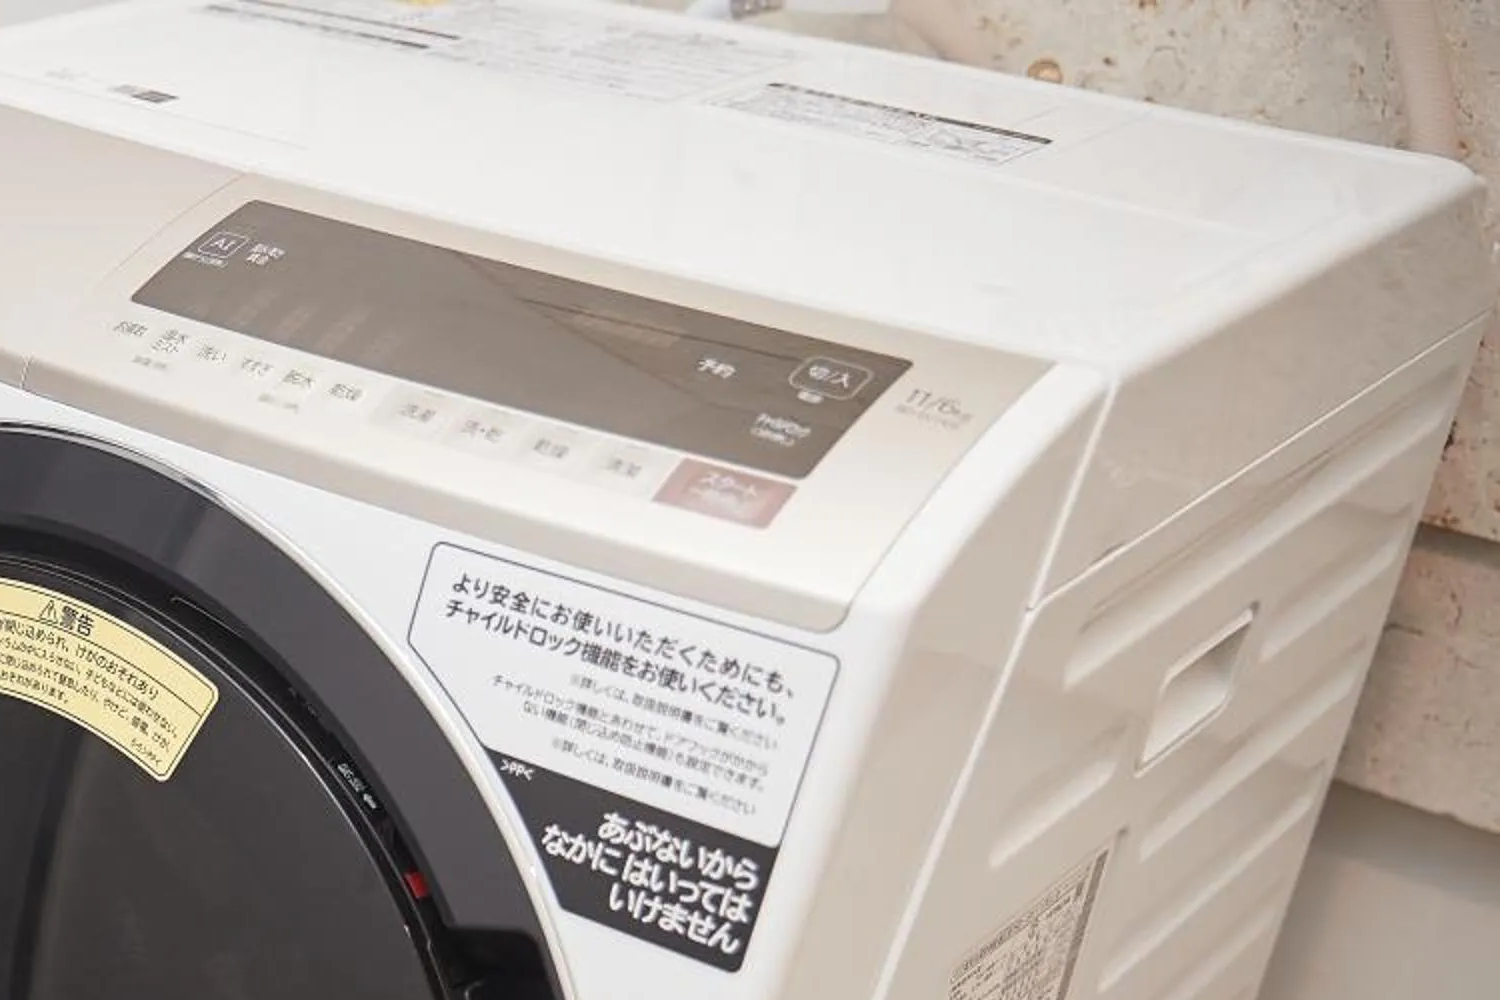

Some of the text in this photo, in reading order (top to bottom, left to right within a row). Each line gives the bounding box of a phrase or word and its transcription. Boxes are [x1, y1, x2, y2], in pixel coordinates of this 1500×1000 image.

[60, 603, 97, 637] 警告
[445, 600, 786, 726] チャイルドロック機能をお使いください。
[451, 573, 795, 699] より安全にお使いいただくためにも、
[541, 823, 753, 924] なかにはいっては
[597, 811, 761, 890] あぶないから
[608, 883, 741, 954] いけません
